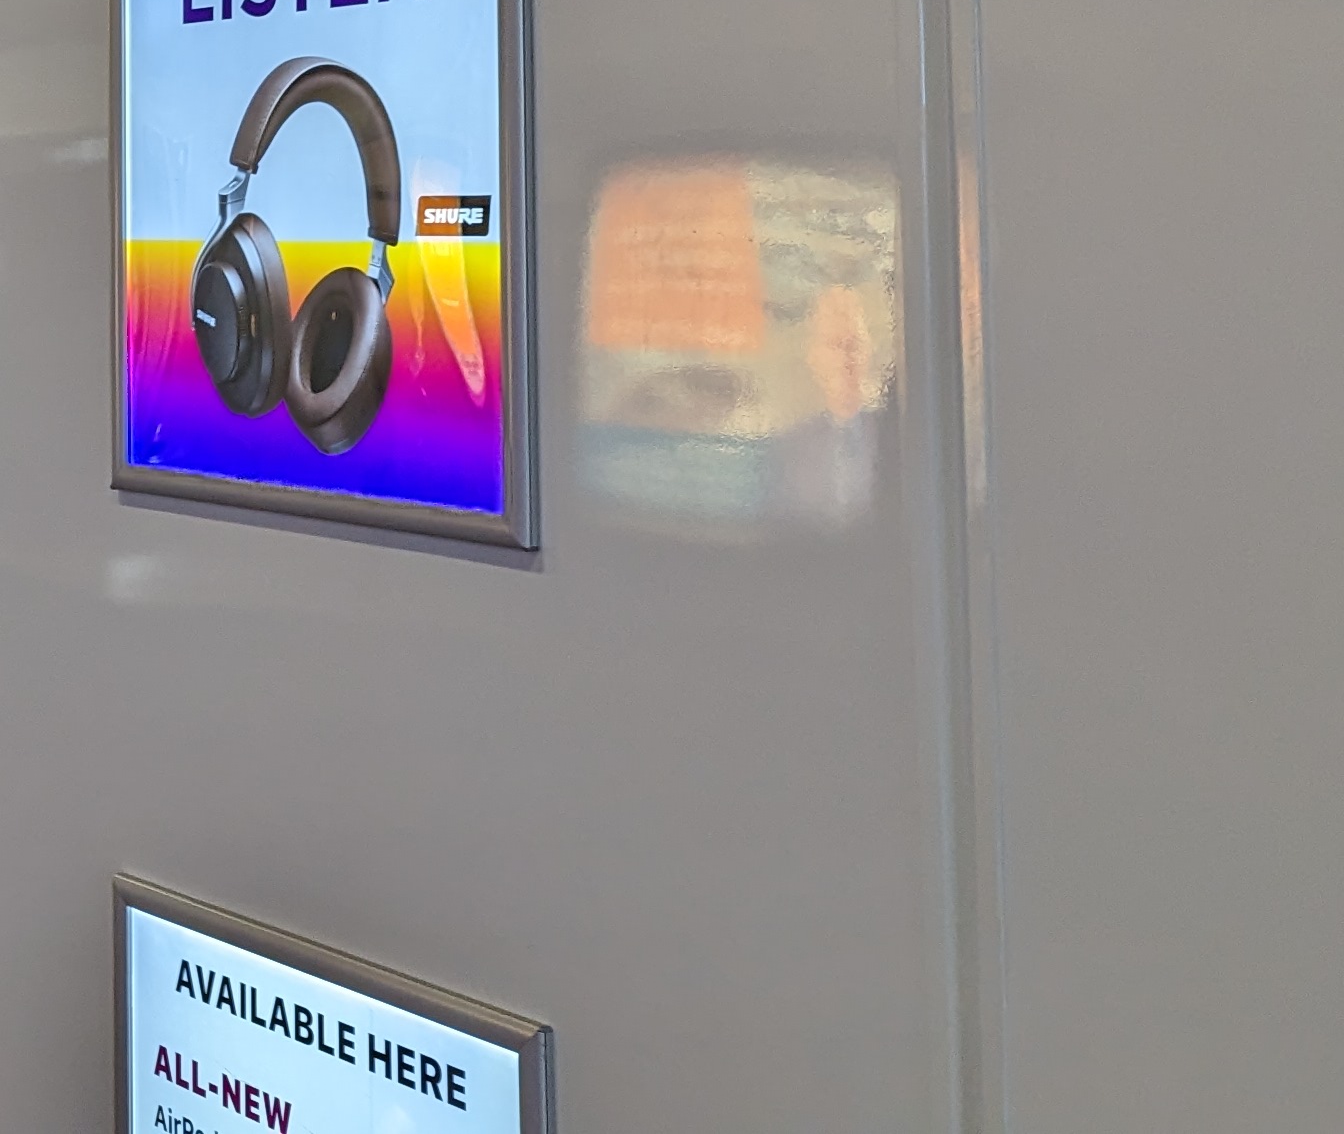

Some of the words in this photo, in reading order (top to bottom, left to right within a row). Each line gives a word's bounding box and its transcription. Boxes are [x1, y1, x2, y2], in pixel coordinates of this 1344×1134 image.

[423, 207, 484, 226] SHURE
[175, 959, 357, 1065] AVAILABLE
[367, 1032, 467, 1112] HERE
[153, 1044, 293, 1134] ALL-NEW
